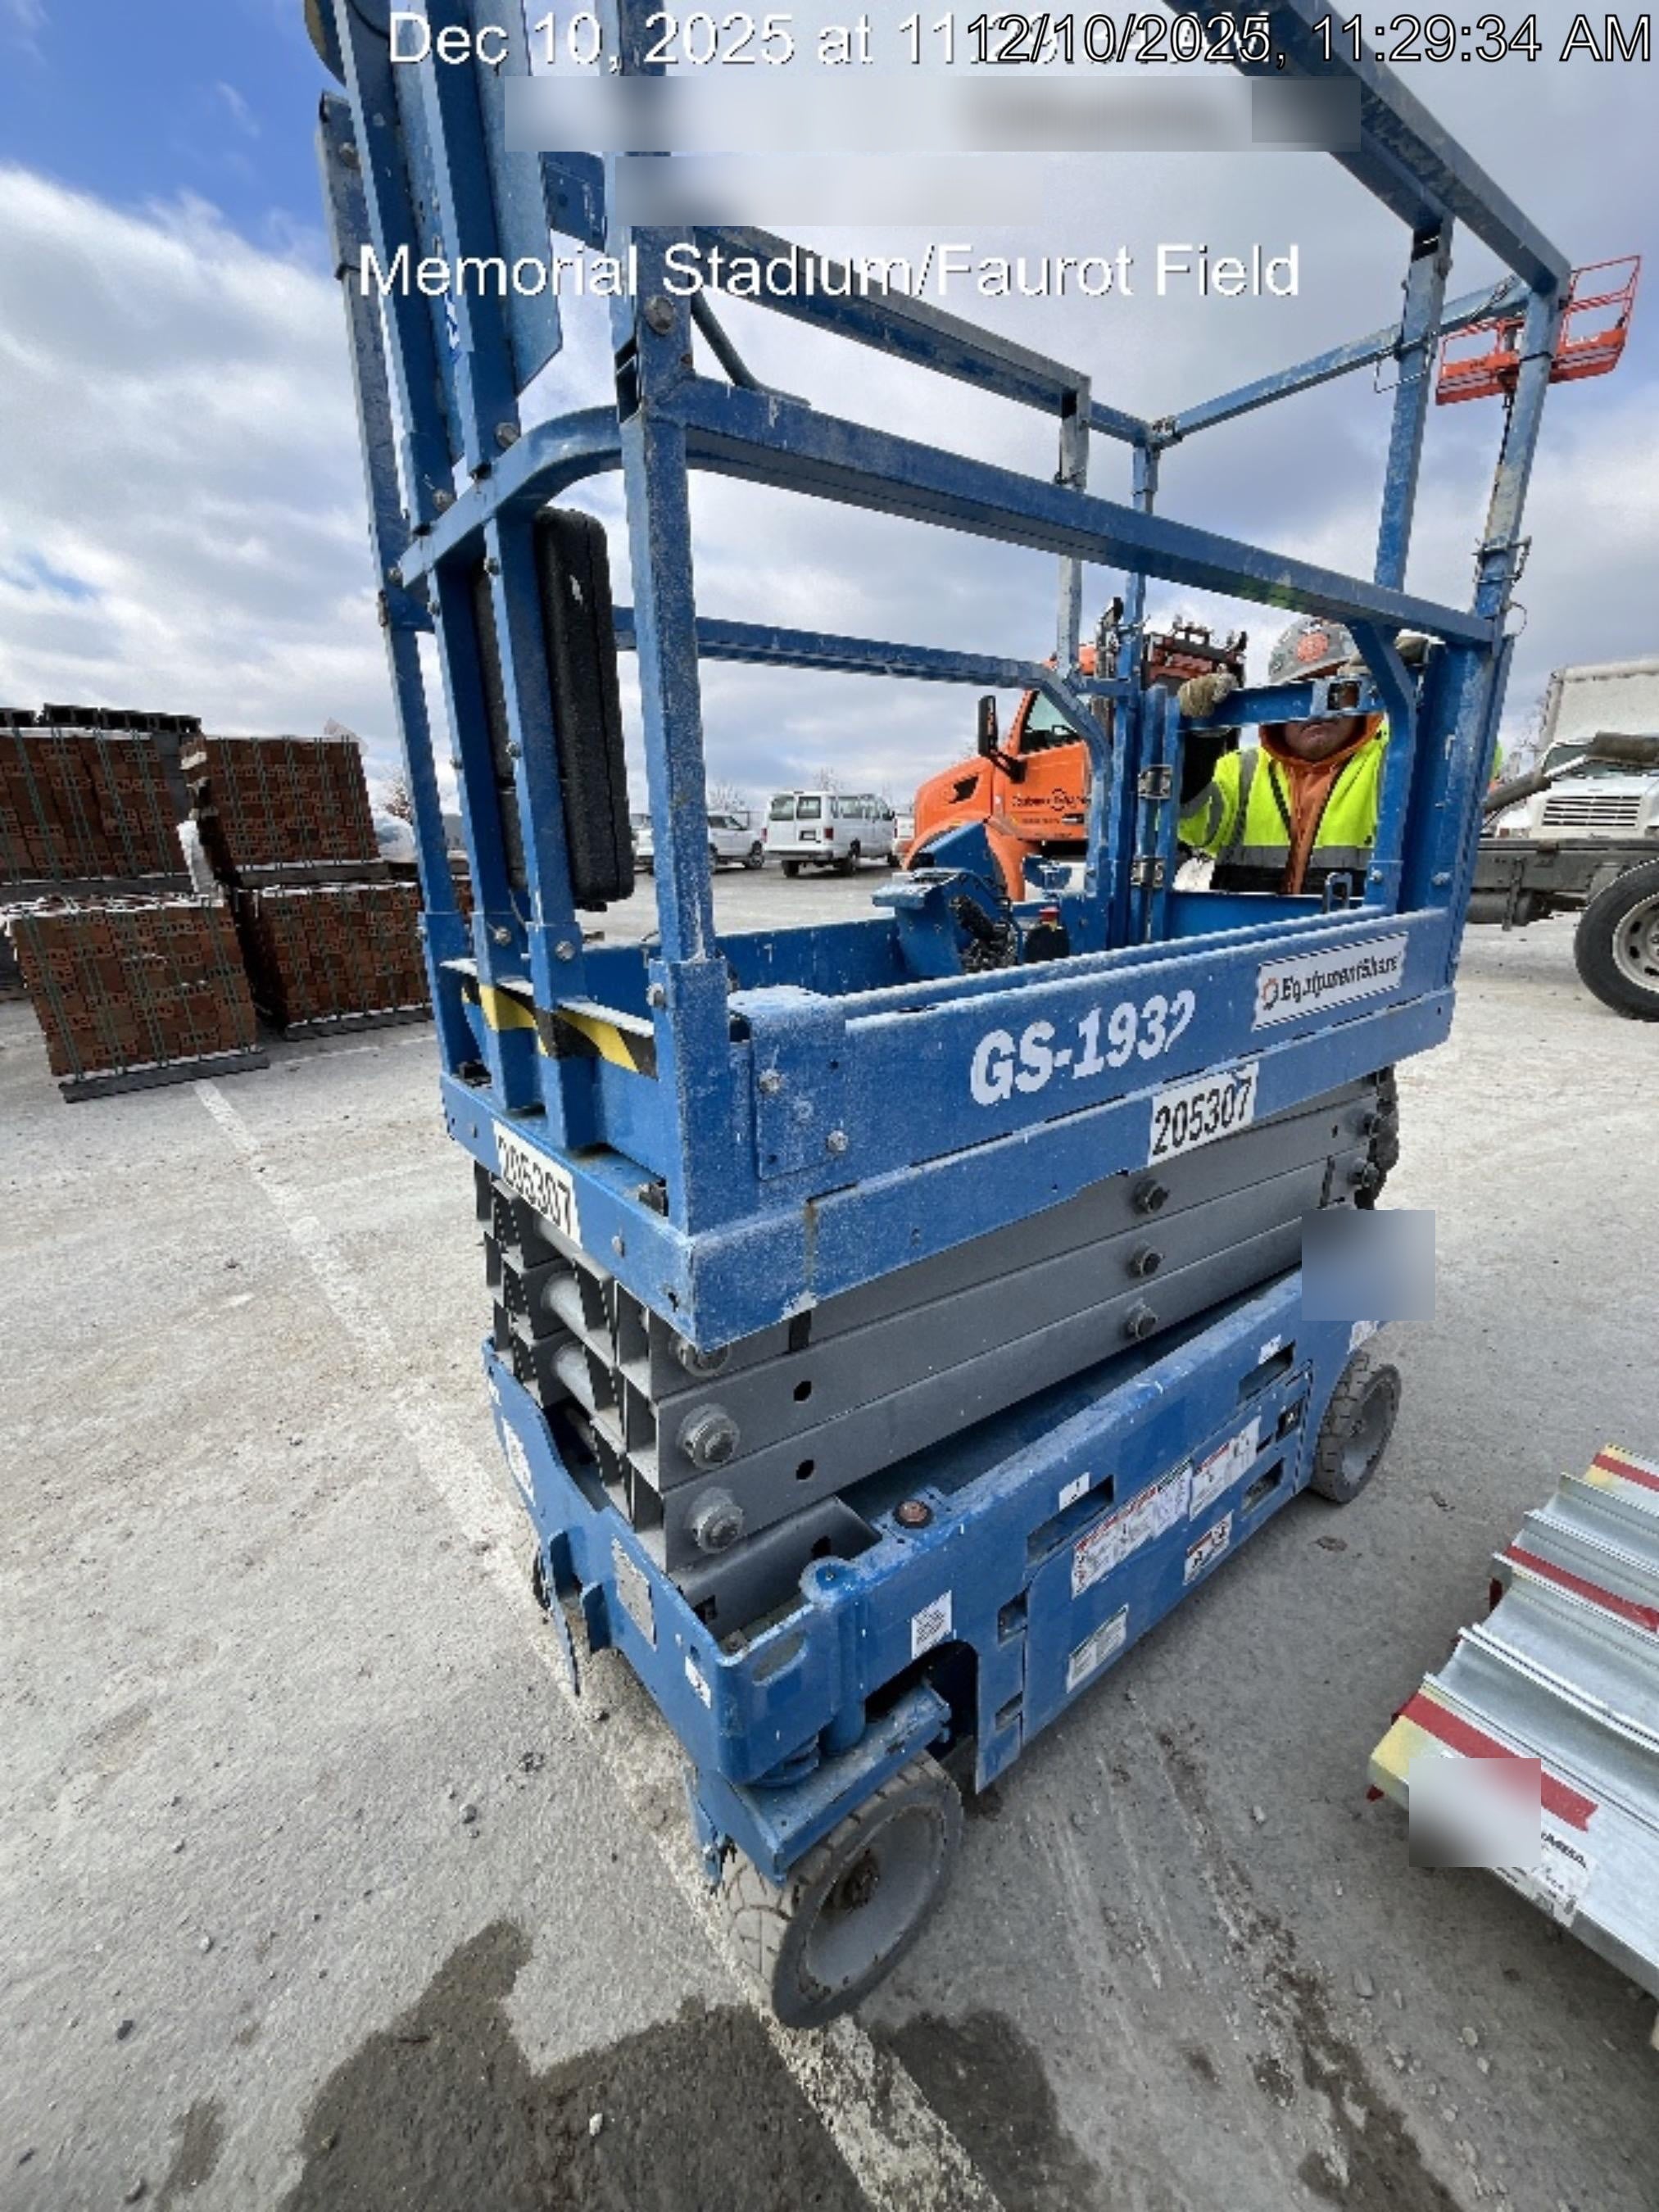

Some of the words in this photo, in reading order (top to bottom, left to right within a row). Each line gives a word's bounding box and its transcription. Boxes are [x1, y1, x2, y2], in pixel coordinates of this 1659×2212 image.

[970, 989, 1196, 1106] GS-1932
[1153, 1074, 1253, 1157] 205307
[497, 1134, 572, 1237] 205307
